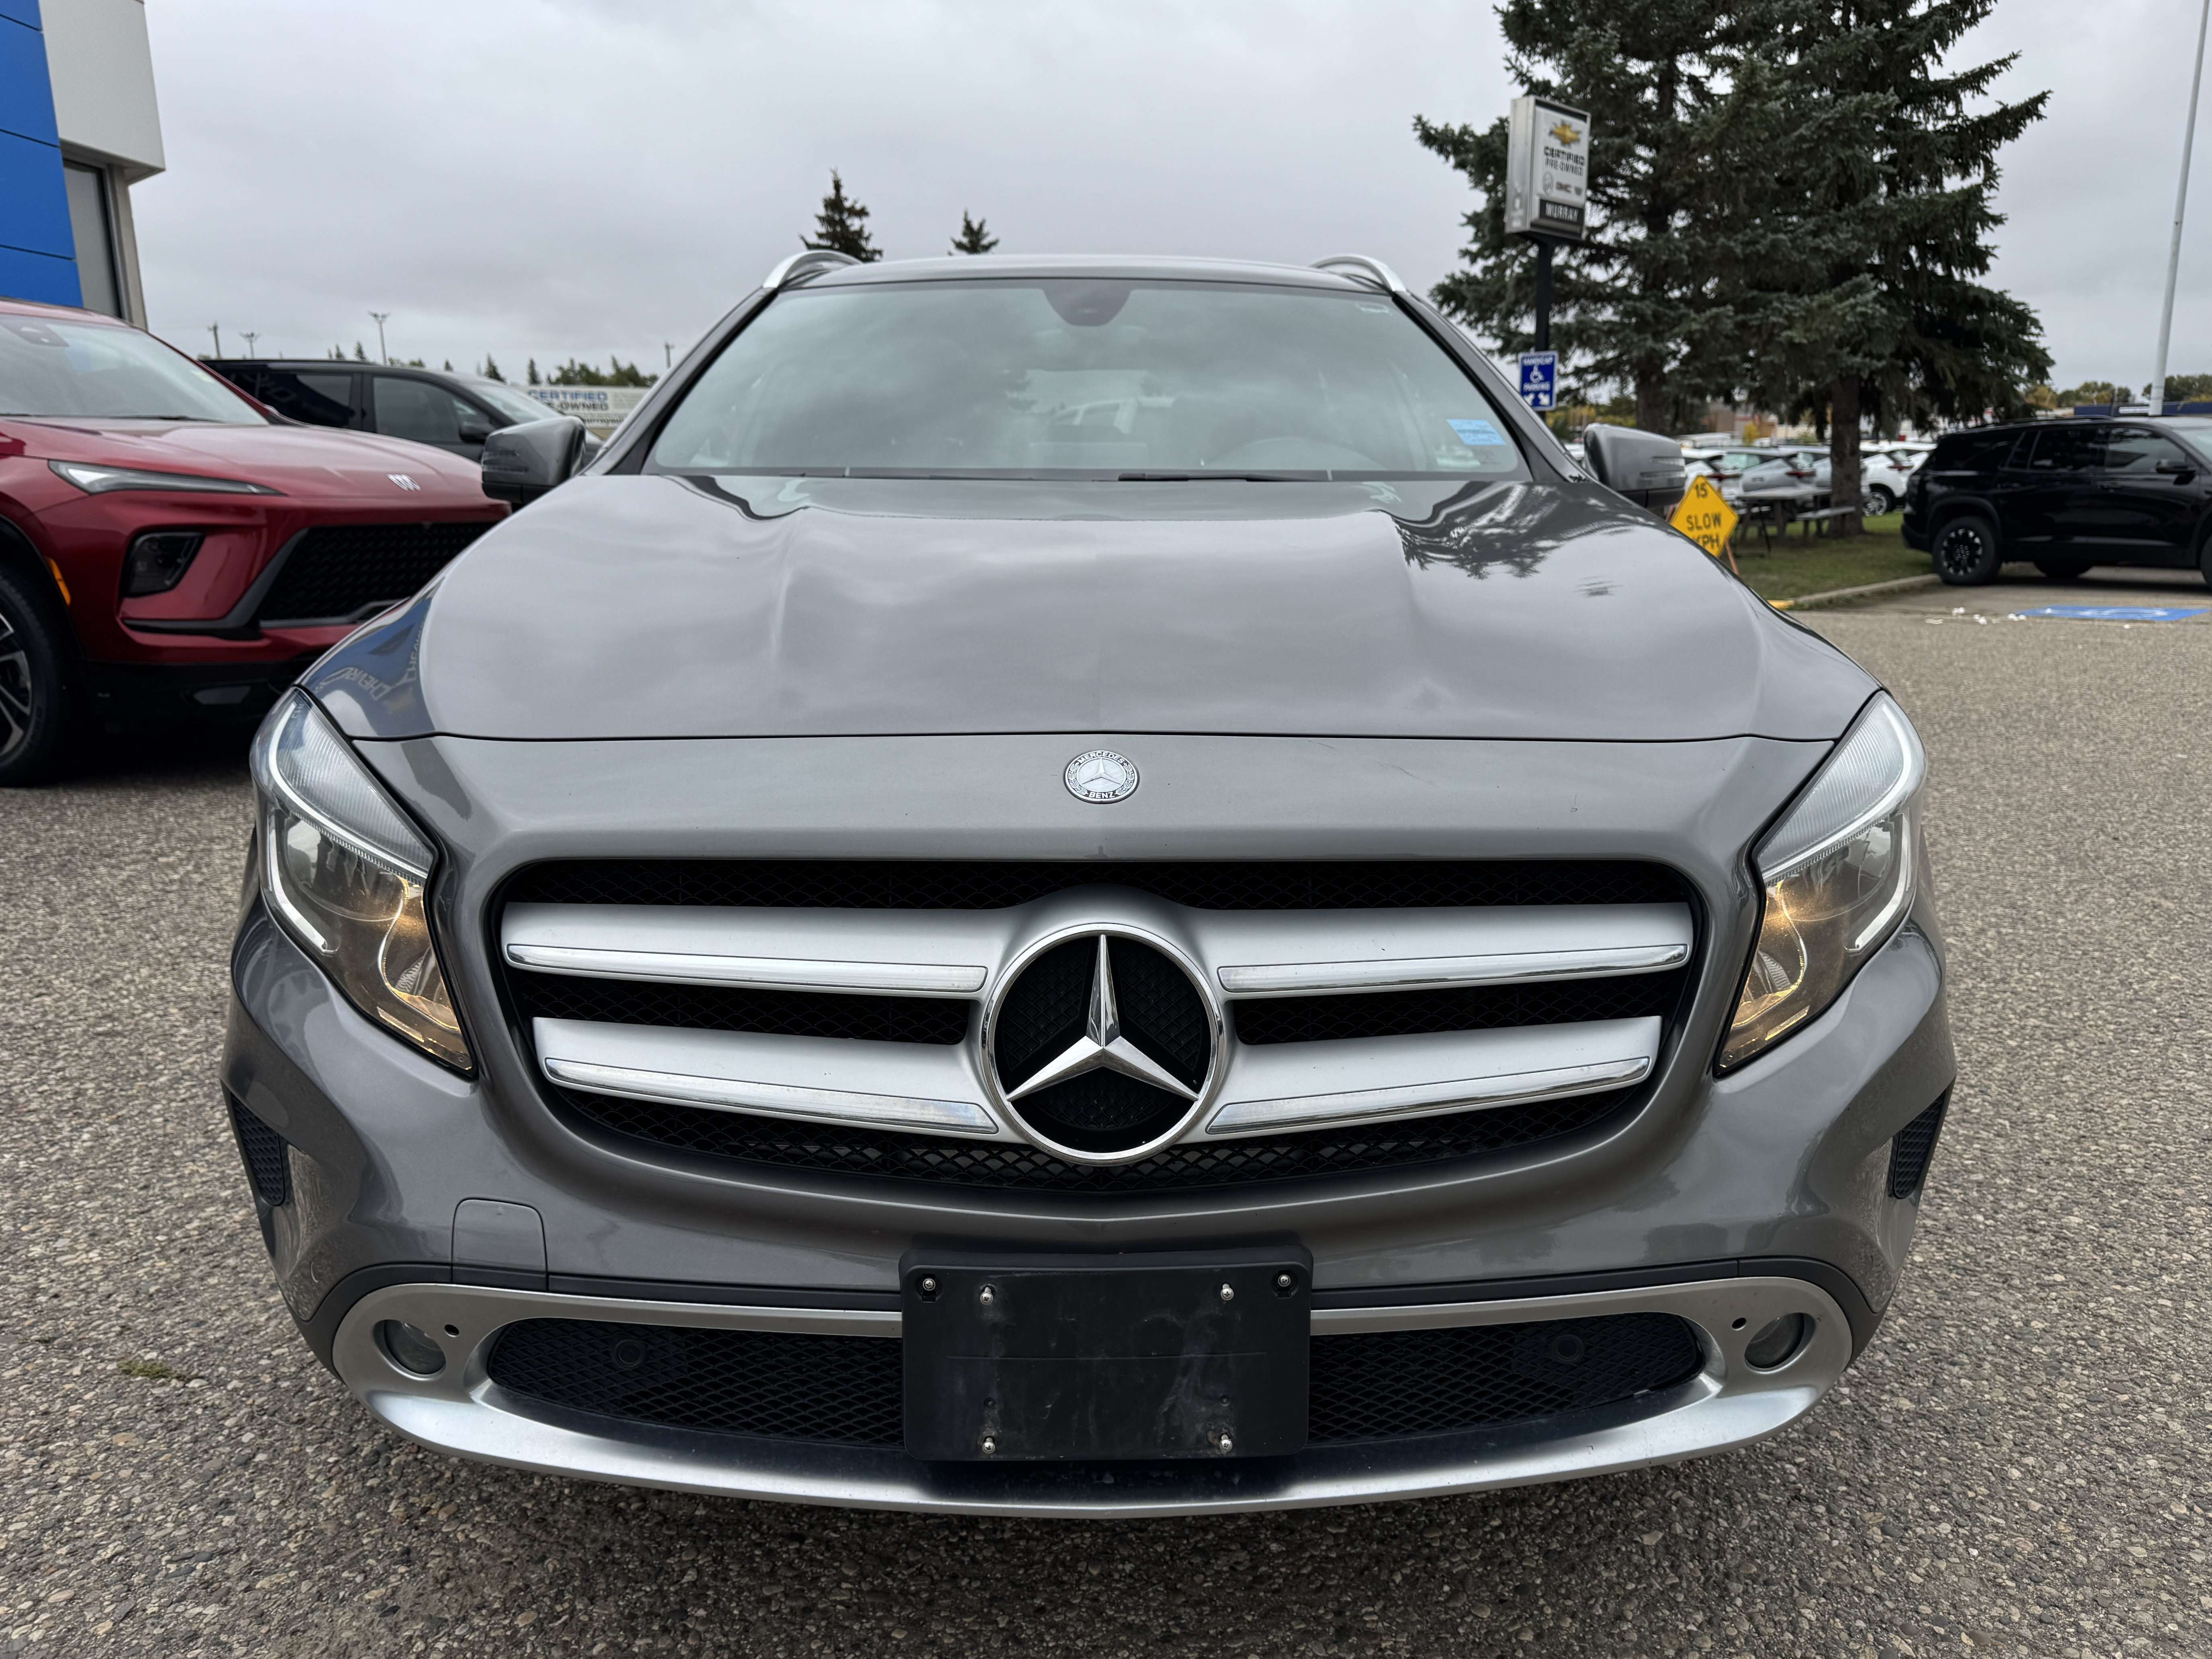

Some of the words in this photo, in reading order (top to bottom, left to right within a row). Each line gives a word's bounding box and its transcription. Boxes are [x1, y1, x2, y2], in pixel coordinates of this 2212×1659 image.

[1544, 146, 1585, 166] CERTIFIED
[1545, 202, 1579, 222] MURRAY
[1523, 356, 1553, 366] HANDICAP
[1523, 382, 1551, 392] PARKING
[527, 390, 608, 401] CERTIFIED
[1695, 483, 1708, 498] 15
[1686, 512, 1722, 531] SLOW
[1078, 751, 1124, 764] MERCEDES
